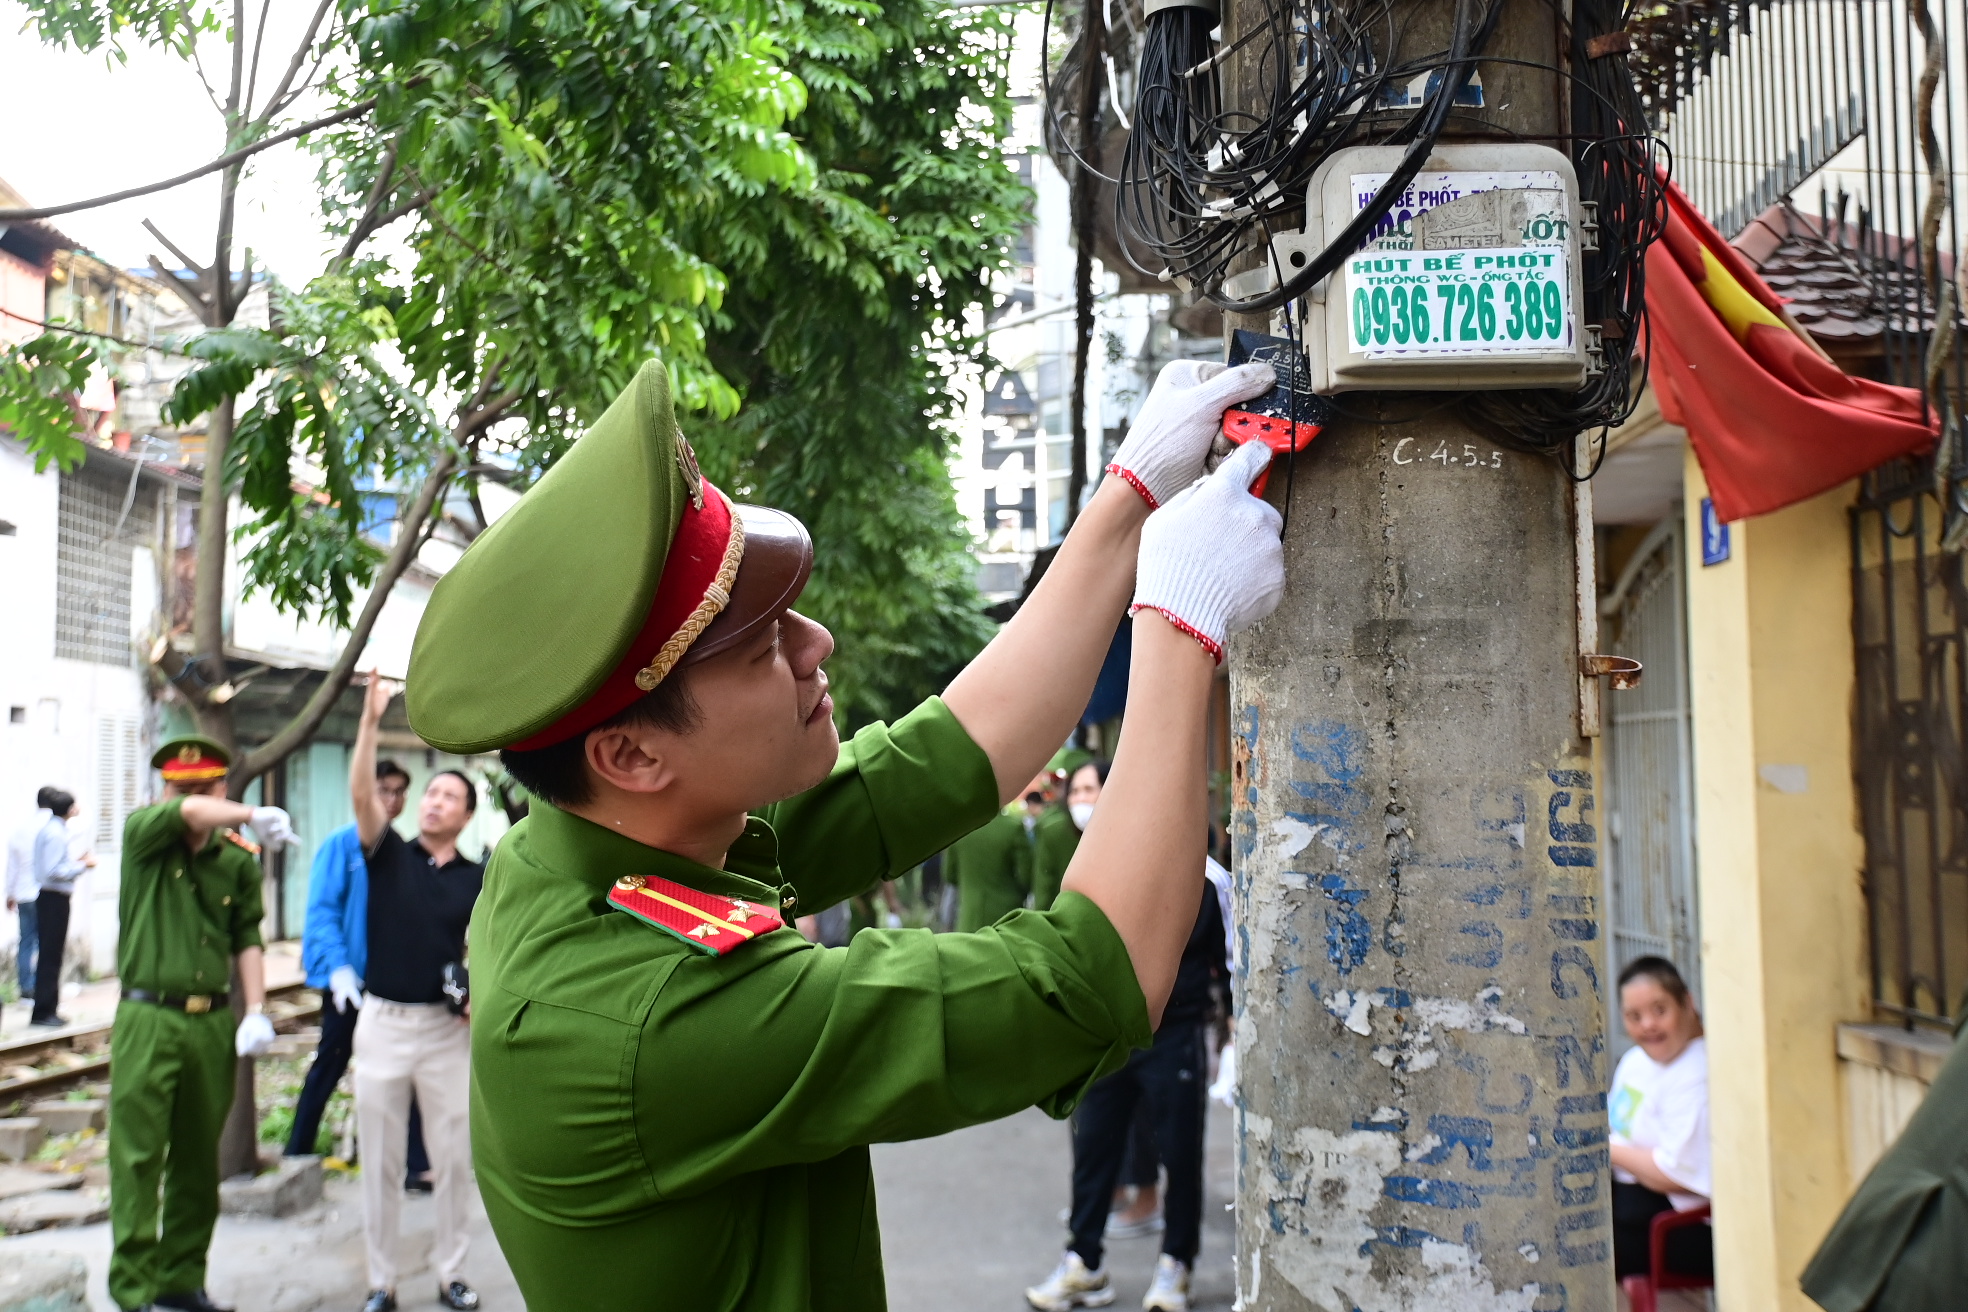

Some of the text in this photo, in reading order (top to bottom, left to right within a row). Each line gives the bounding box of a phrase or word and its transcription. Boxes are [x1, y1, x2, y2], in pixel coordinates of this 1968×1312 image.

[1352, 250, 1556, 275] HÚT BỂ PHỐT
[1365, 273, 1431, 286] THÔNG
[1436, 273, 1467, 283] WC
[1352, 280, 1562, 347] 0936.726.389
